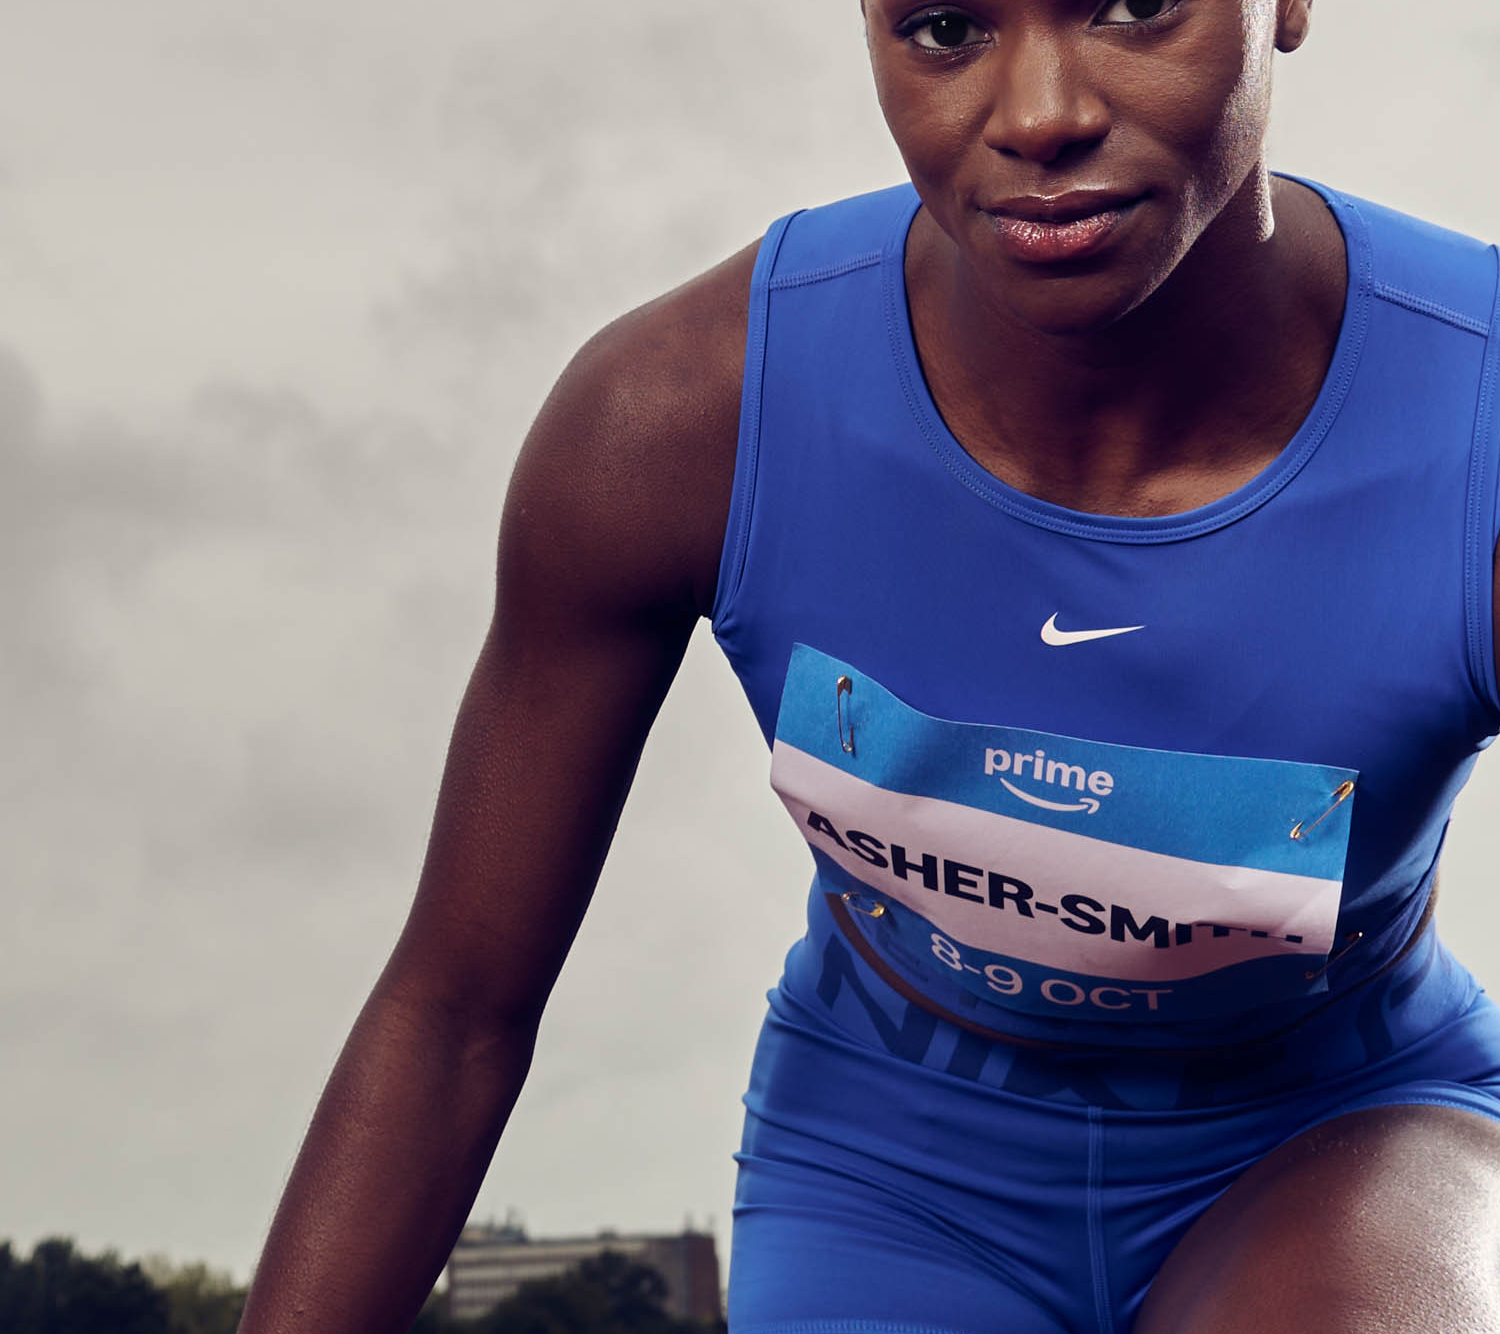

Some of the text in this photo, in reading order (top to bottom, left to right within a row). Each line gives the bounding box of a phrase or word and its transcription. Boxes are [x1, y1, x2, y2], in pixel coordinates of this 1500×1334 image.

[984, 748, 1114, 797] prime
[931, 933, 1173, 1011] 8-9 OCT
